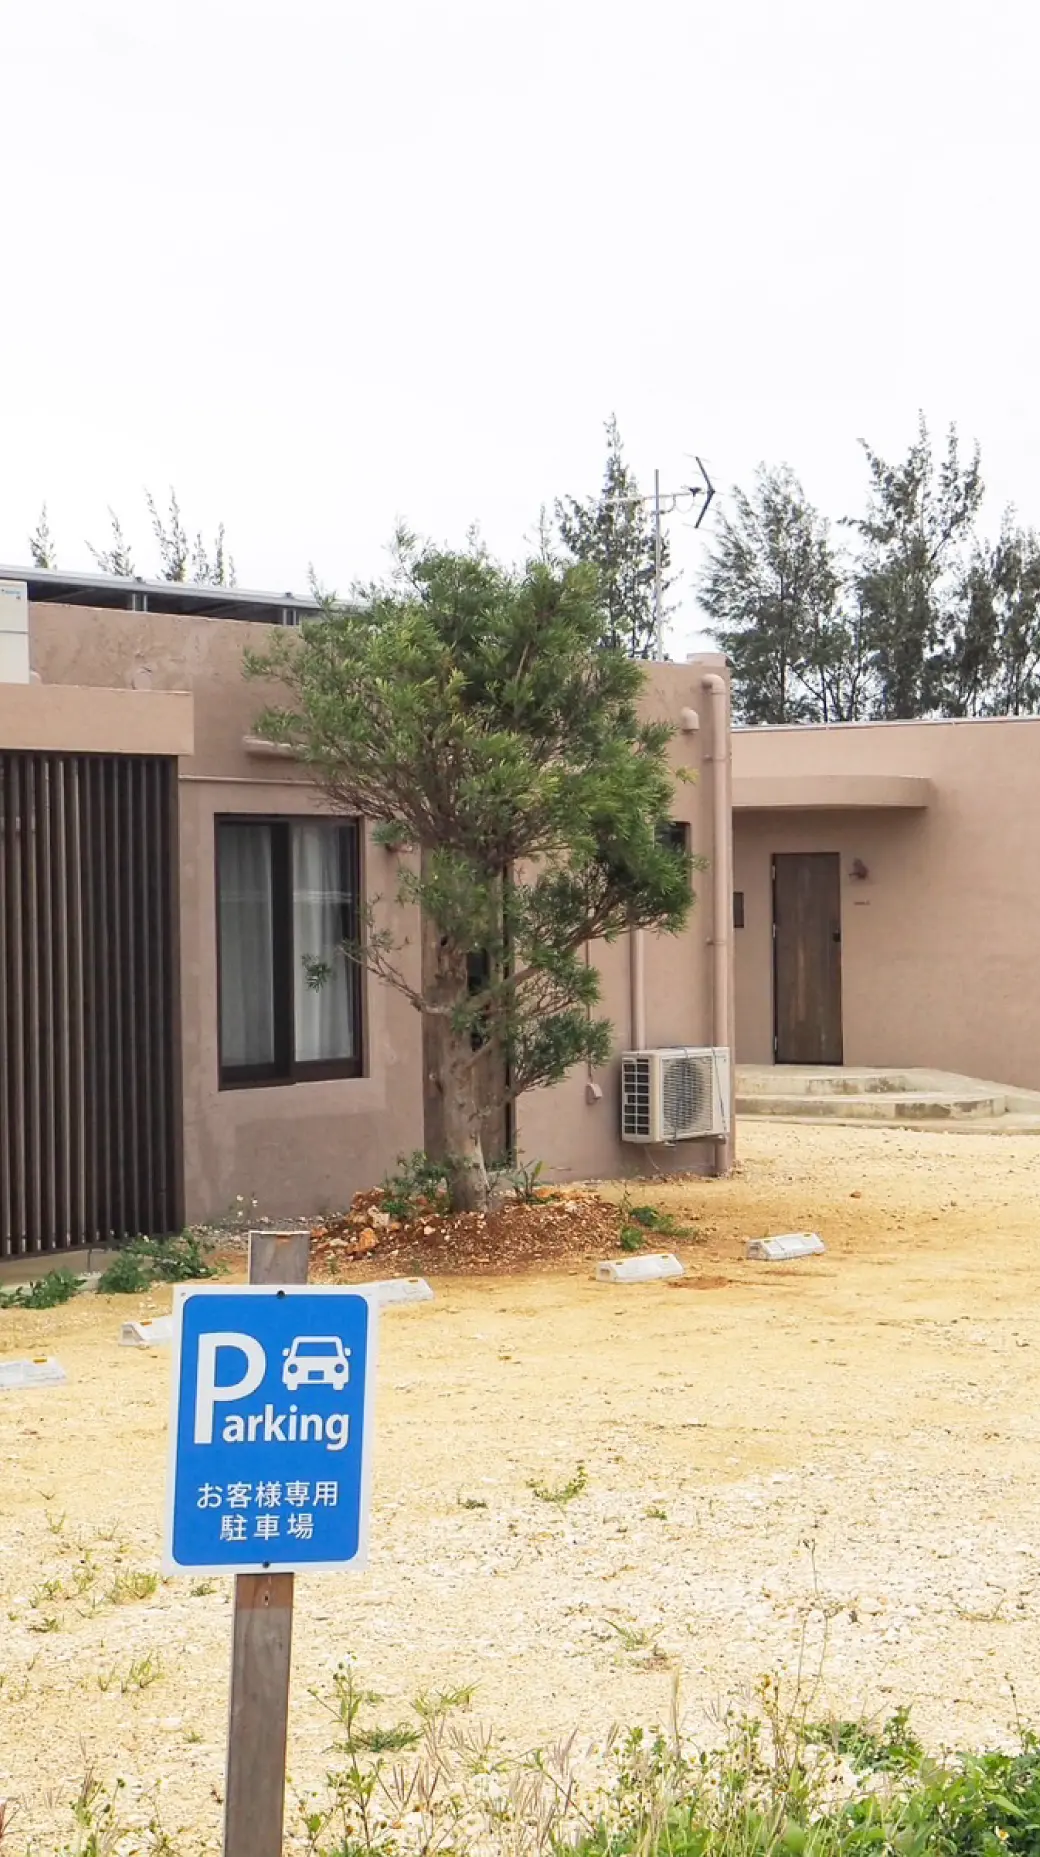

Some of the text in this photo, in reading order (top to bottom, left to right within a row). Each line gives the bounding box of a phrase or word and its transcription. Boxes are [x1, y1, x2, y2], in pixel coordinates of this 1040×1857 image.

[193, 1332, 350, 1452] Parking
[196, 1480, 339, 1509] お客様専用
[219, 1513, 315, 1542] 駐車場
